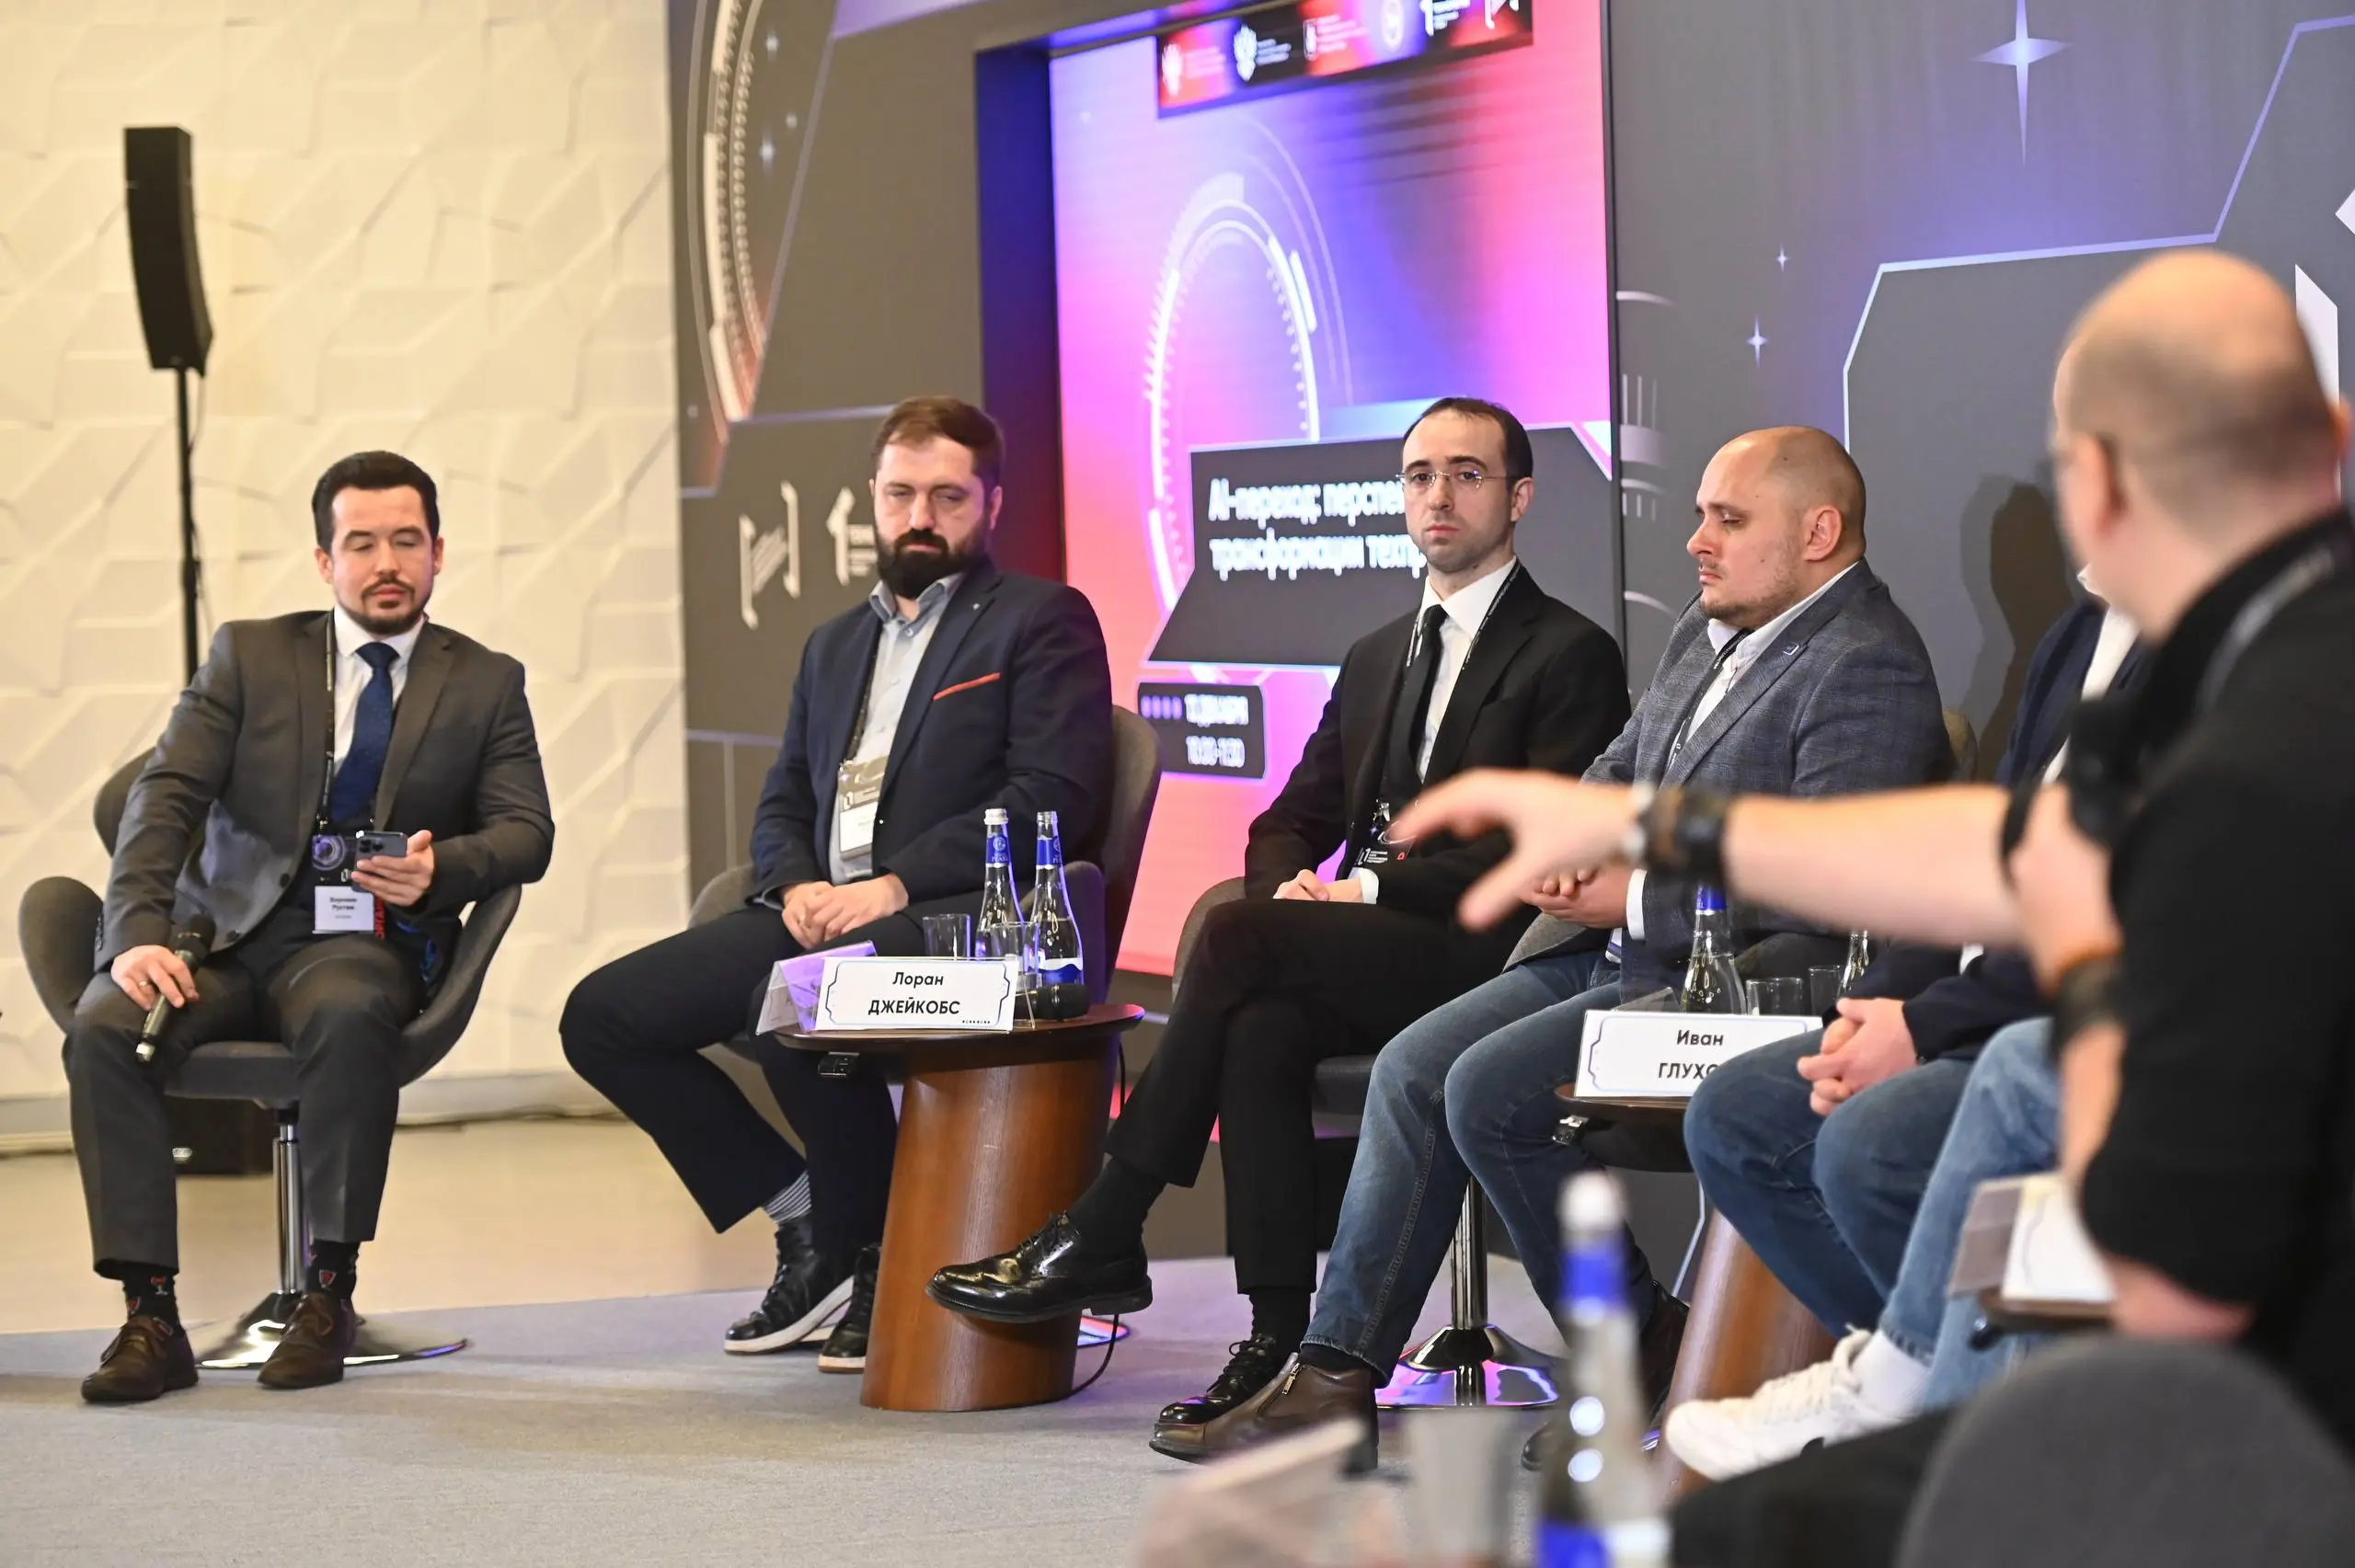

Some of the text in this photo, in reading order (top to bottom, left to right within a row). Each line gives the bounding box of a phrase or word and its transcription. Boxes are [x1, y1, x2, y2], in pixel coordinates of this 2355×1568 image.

[892, 971, 944, 990] Лоран
[867, 996, 960, 1016] ДЖЕЙКОБС
[1676, 1029, 1724, 1046] Иван
